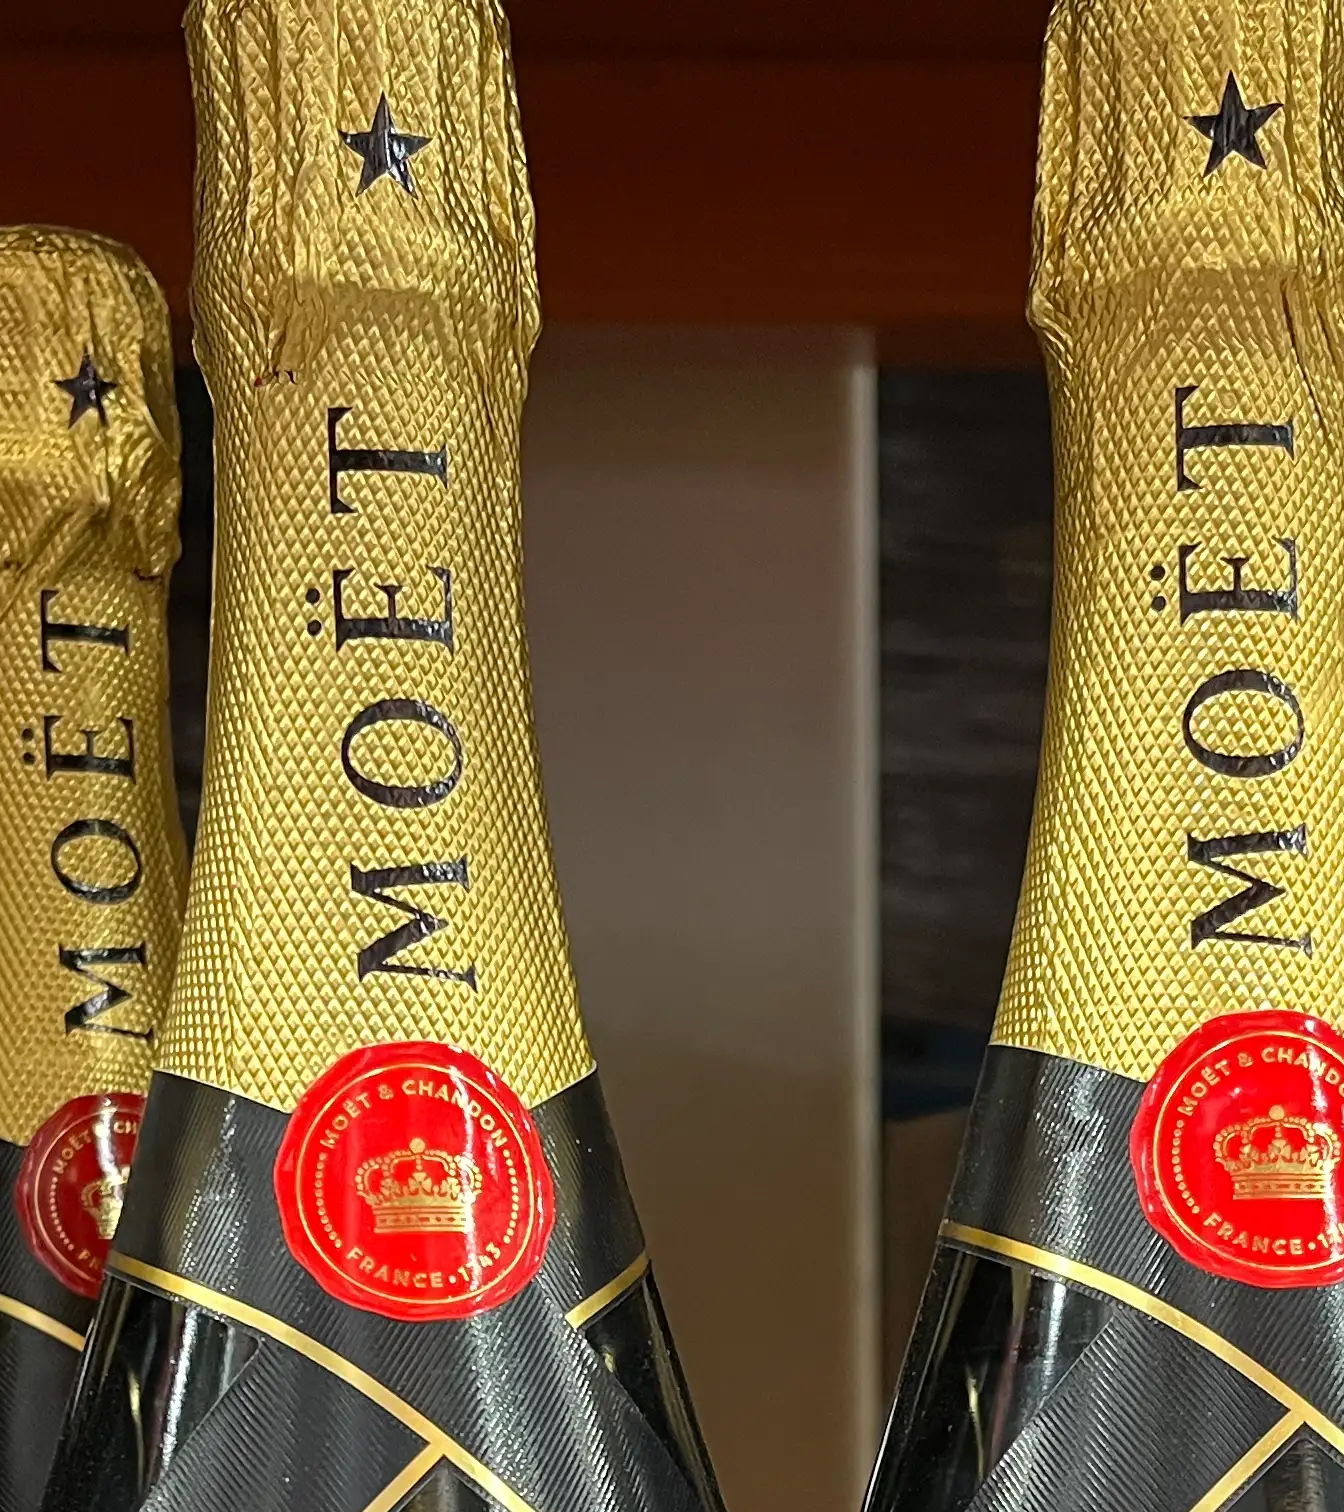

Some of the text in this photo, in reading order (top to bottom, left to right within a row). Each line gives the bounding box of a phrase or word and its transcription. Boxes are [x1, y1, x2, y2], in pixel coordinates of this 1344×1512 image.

[21, 589, 156, 1045] MOËT
[305, 406, 479, 994] MOËT
[1149, 383, 1313, 959] MOËT
[379, 1083, 395, 1101] &
[401, 1079, 508, 1149] CHANDON
[1237, 1052, 1254, 1068] &
